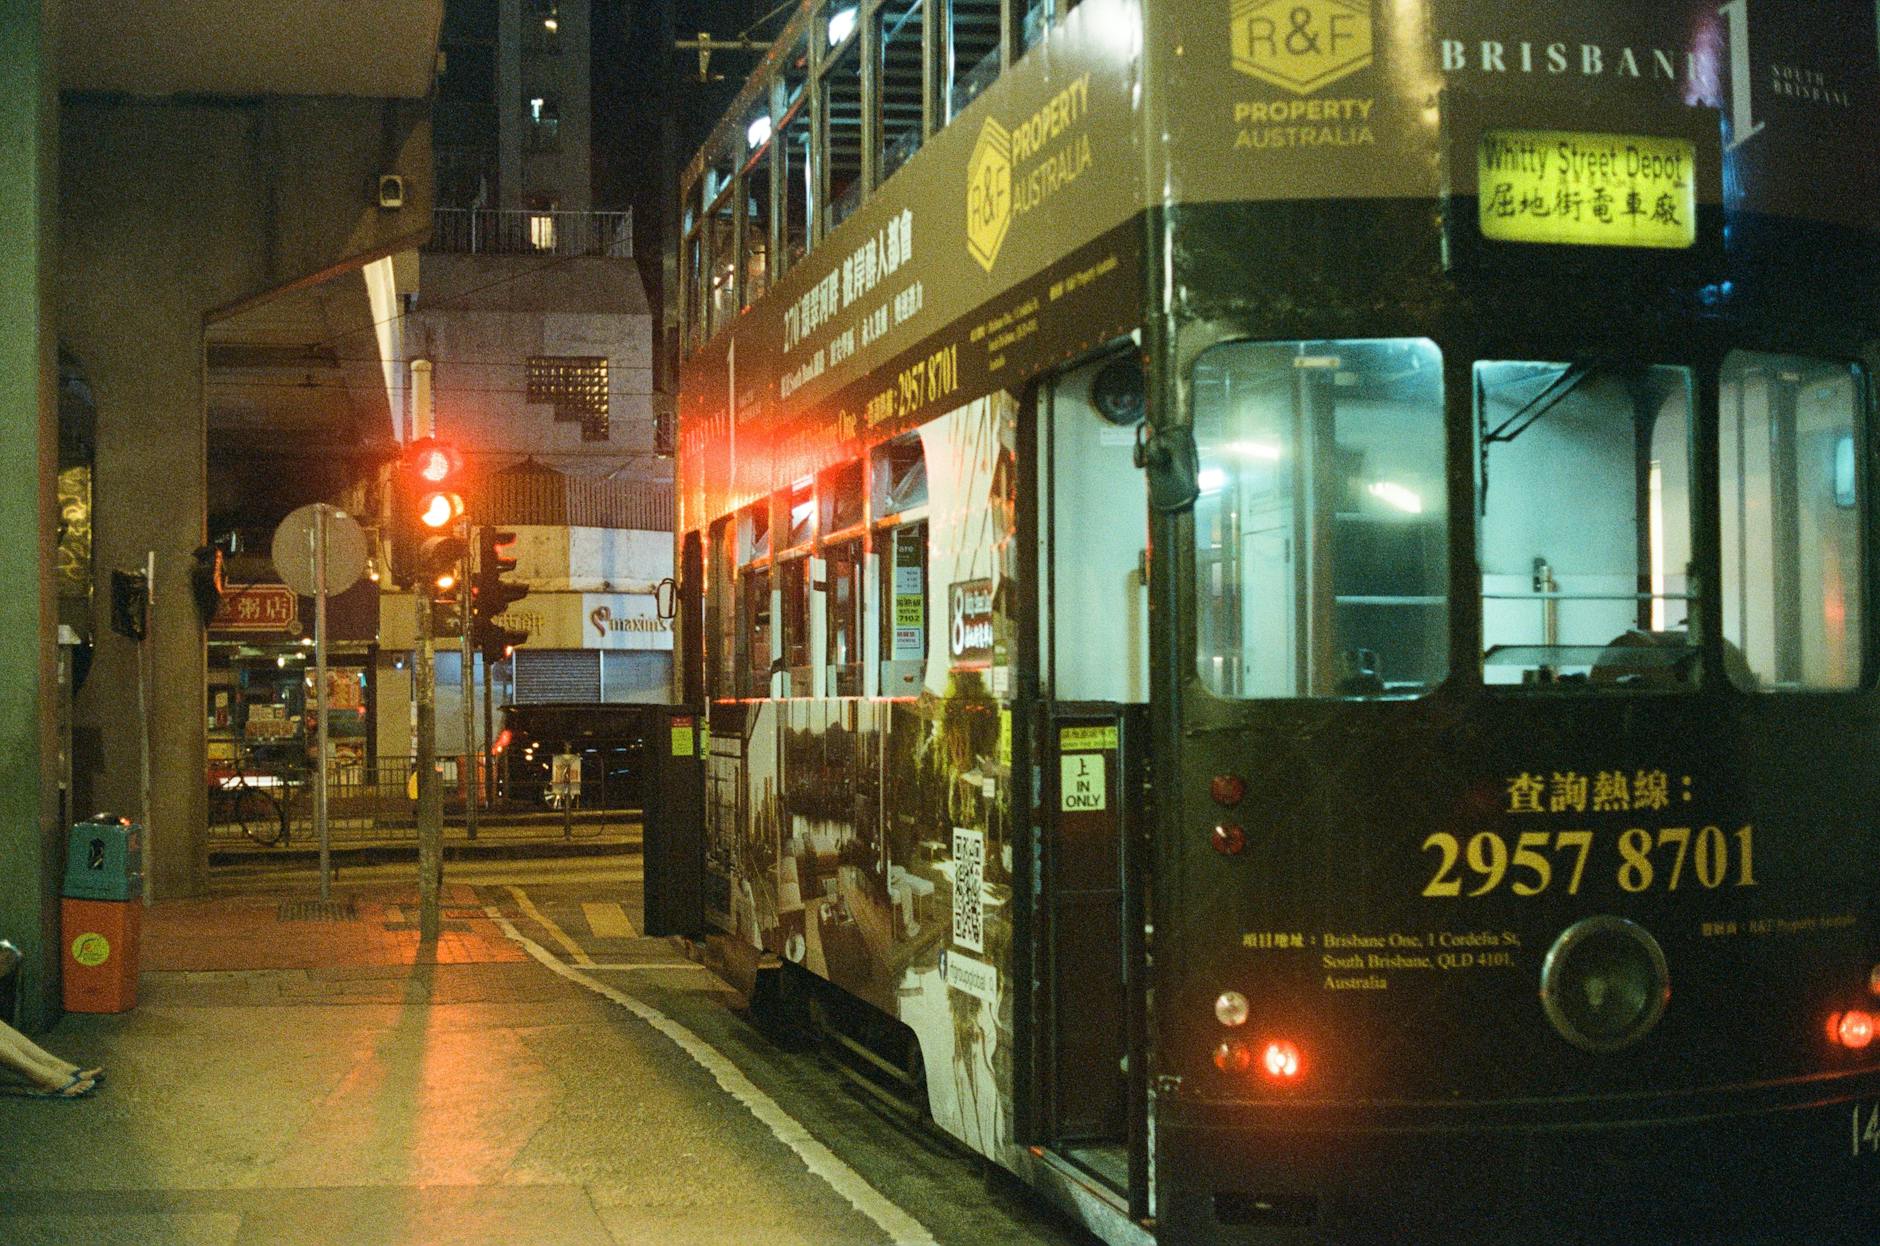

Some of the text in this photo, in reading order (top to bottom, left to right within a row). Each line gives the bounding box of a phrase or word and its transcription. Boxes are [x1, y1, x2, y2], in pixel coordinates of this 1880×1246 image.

[1248, 7, 1353, 56] R&F
[1012, 71, 1089, 168] PROPERTY
[1234, 98, 1374, 122] PROPERTY
[1234, 127, 1375, 147] AUSTRALIA
[1012, 134, 1093, 216] AUSTRALIA
[1485, 138, 1682, 184] Whitty Street Depot
[972, 163, 1006, 235] R&F
[1488, 183, 1681, 226] 屈地街電車廠
[899, 361, 925, 417] 2957
[928, 344, 958, 402] 8701
[1077, 758, 1090, 777] 上
[1065, 795, 1101, 808] ONLY
[1077, 781, 1090, 792] IN
[1422, 824, 1760, 897] 2957 8701
[1323, 932, 1386, 948] Brisbane
[1323, 954, 1364, 969] South
[1438, 953, 1474, 969] QLD
[1324, 975, 1388, 990] Australia
